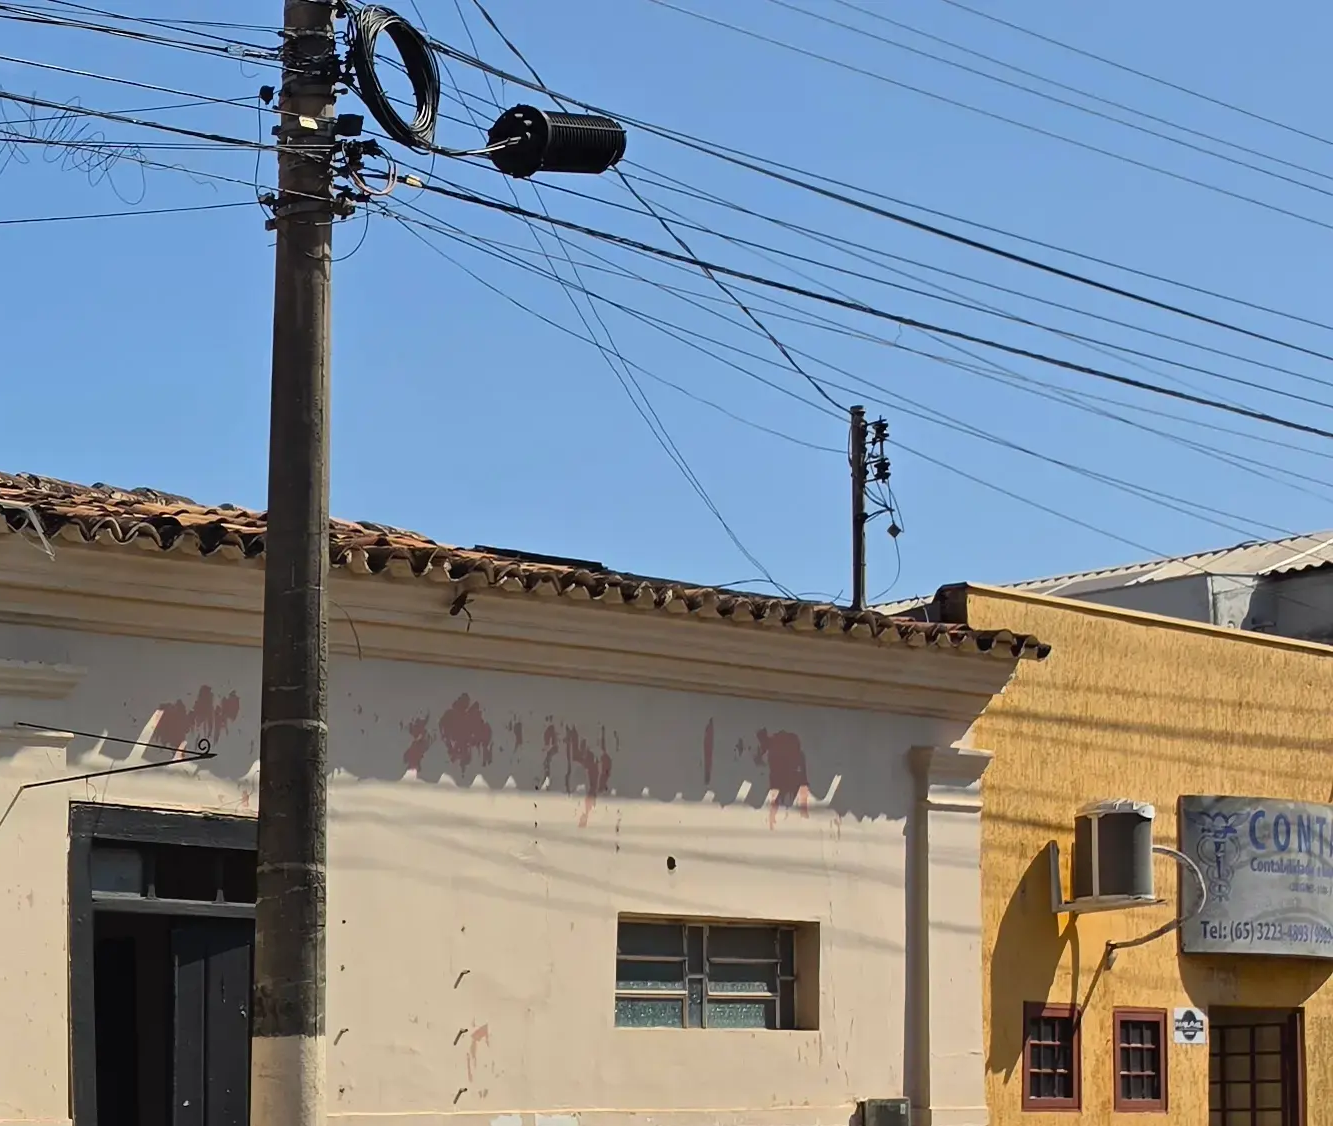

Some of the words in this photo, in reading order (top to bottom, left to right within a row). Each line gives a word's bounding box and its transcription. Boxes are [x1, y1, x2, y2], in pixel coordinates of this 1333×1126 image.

[1249, 810, 1333, 858] CONT
[1201, 921, 1227, 939] Tel:
[1230, 921, 1255, 944] (65)
